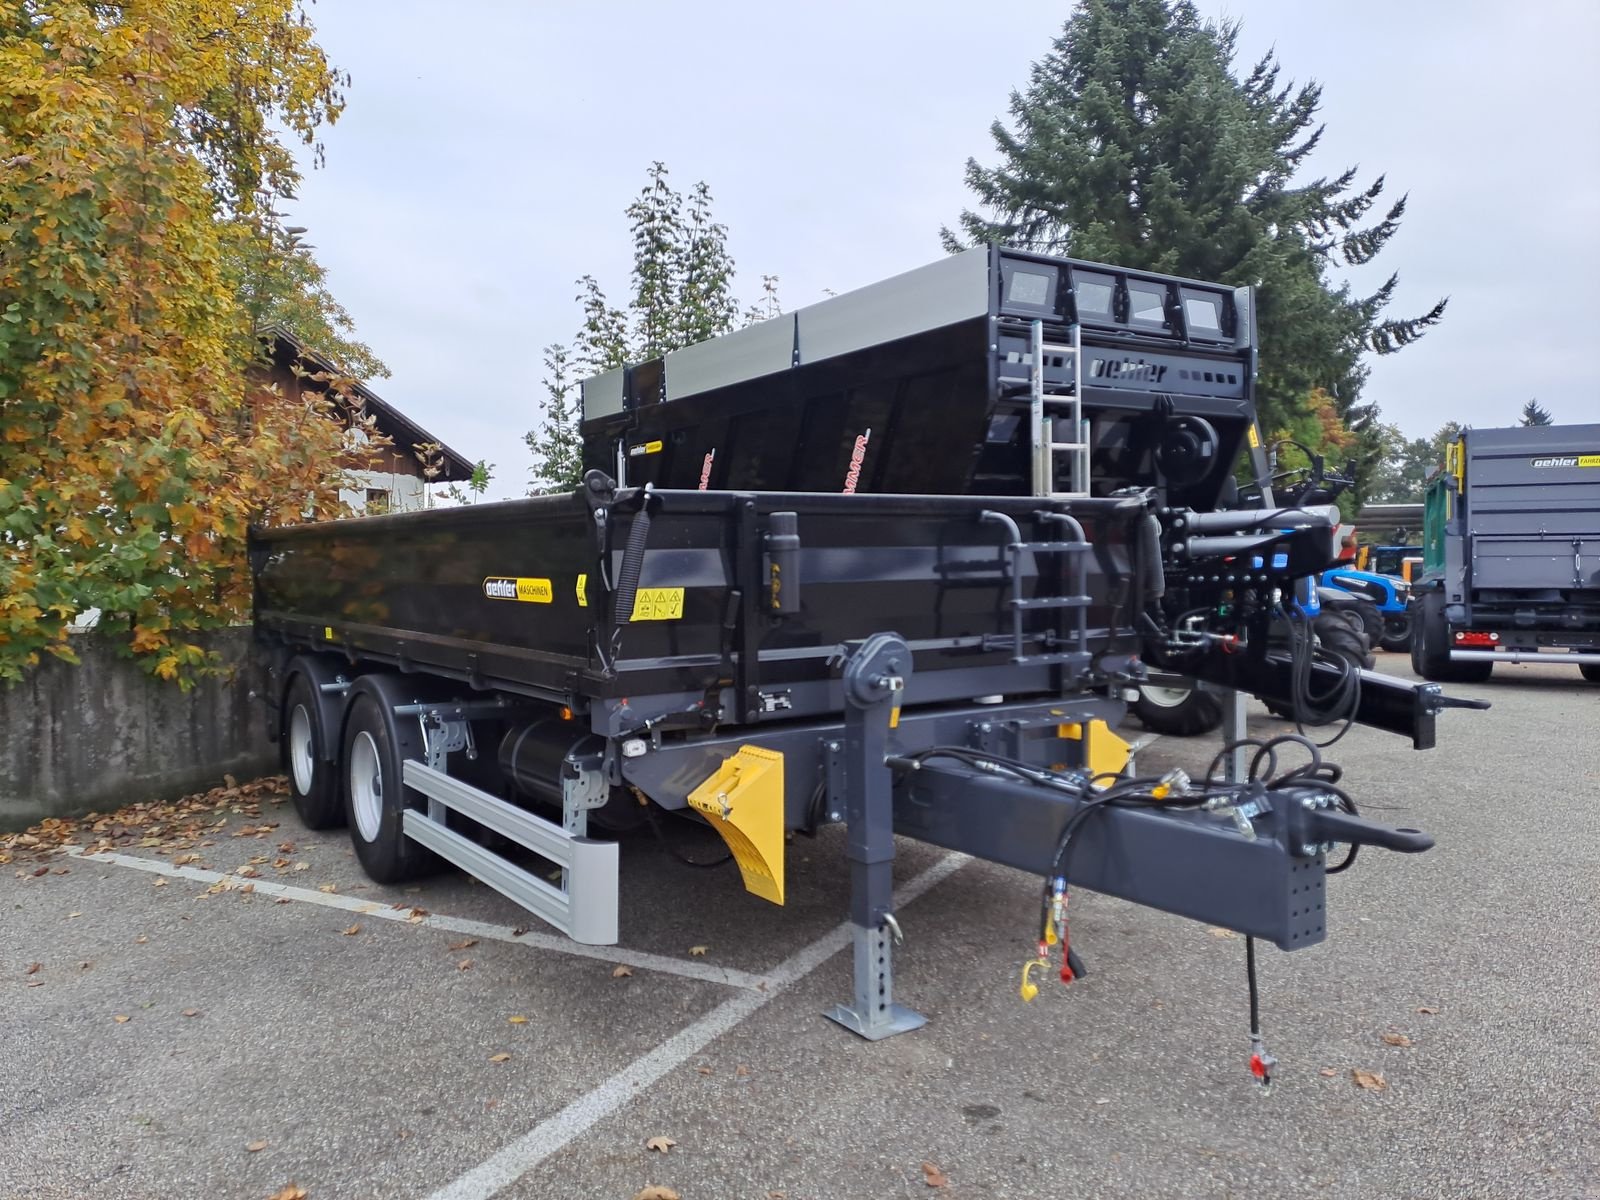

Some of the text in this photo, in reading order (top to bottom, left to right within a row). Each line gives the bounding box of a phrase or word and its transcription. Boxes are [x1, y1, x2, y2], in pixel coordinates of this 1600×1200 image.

[1534, 458, 1577, 467] oehler
[485, 579, 548, 598] oehler MASCHINEN
